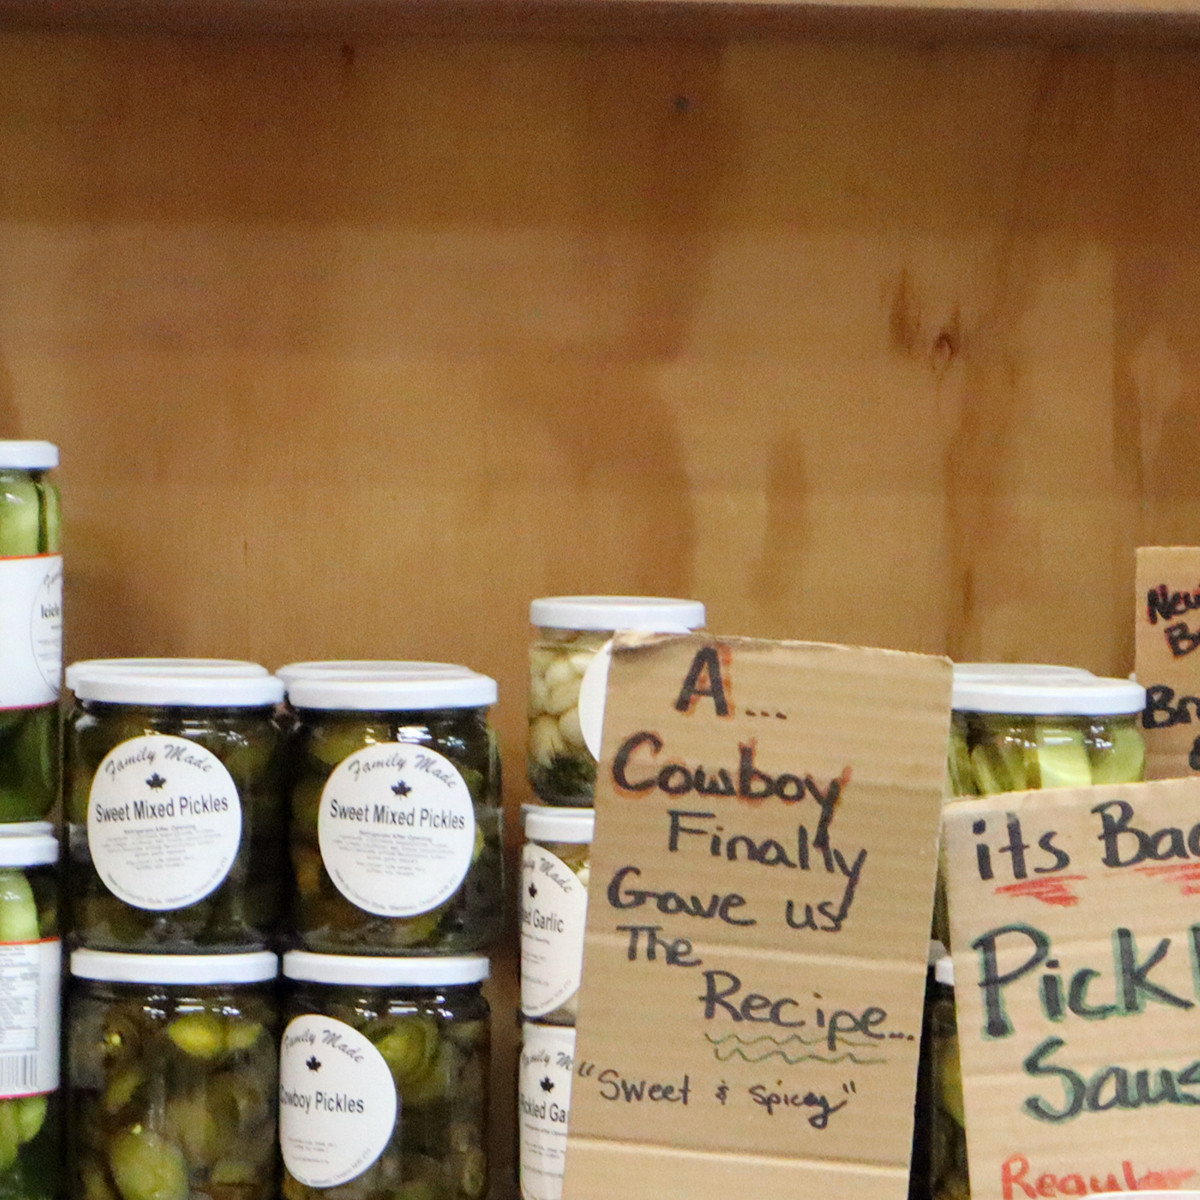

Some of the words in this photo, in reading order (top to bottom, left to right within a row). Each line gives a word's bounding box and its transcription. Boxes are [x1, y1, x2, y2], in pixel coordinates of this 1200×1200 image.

[105, 746, 157, 782] Family
[164, 744, 213, 773] Made
[348, 753, 407, 782] Family
[415, 754, 457, 788] Made
[611, 730, 852, 848] Cowboy
[96, 803, 131, 823] Sweet
[133, 798, 175, 820] Mixed
[179, 794, 229, 816] Pickles
[330, 799, 369, 822] Sweet
[373, 804, 415, 826] Mixed
[420, 808, 465, 830] Pickles
[971, 812, 1071, 881] its
[540, 857, 573, 894] Made
[667, 809, 868, 923] Finally
[606, 865, 756, 927] Gave
[785, 898, 844, 932] us
[533, 909, 564, 933] Garlic
[616, 925, 703, 968] The
[322, 1029, 364, 1064] Made
[315, 1090, 364, 1114] Pickles
